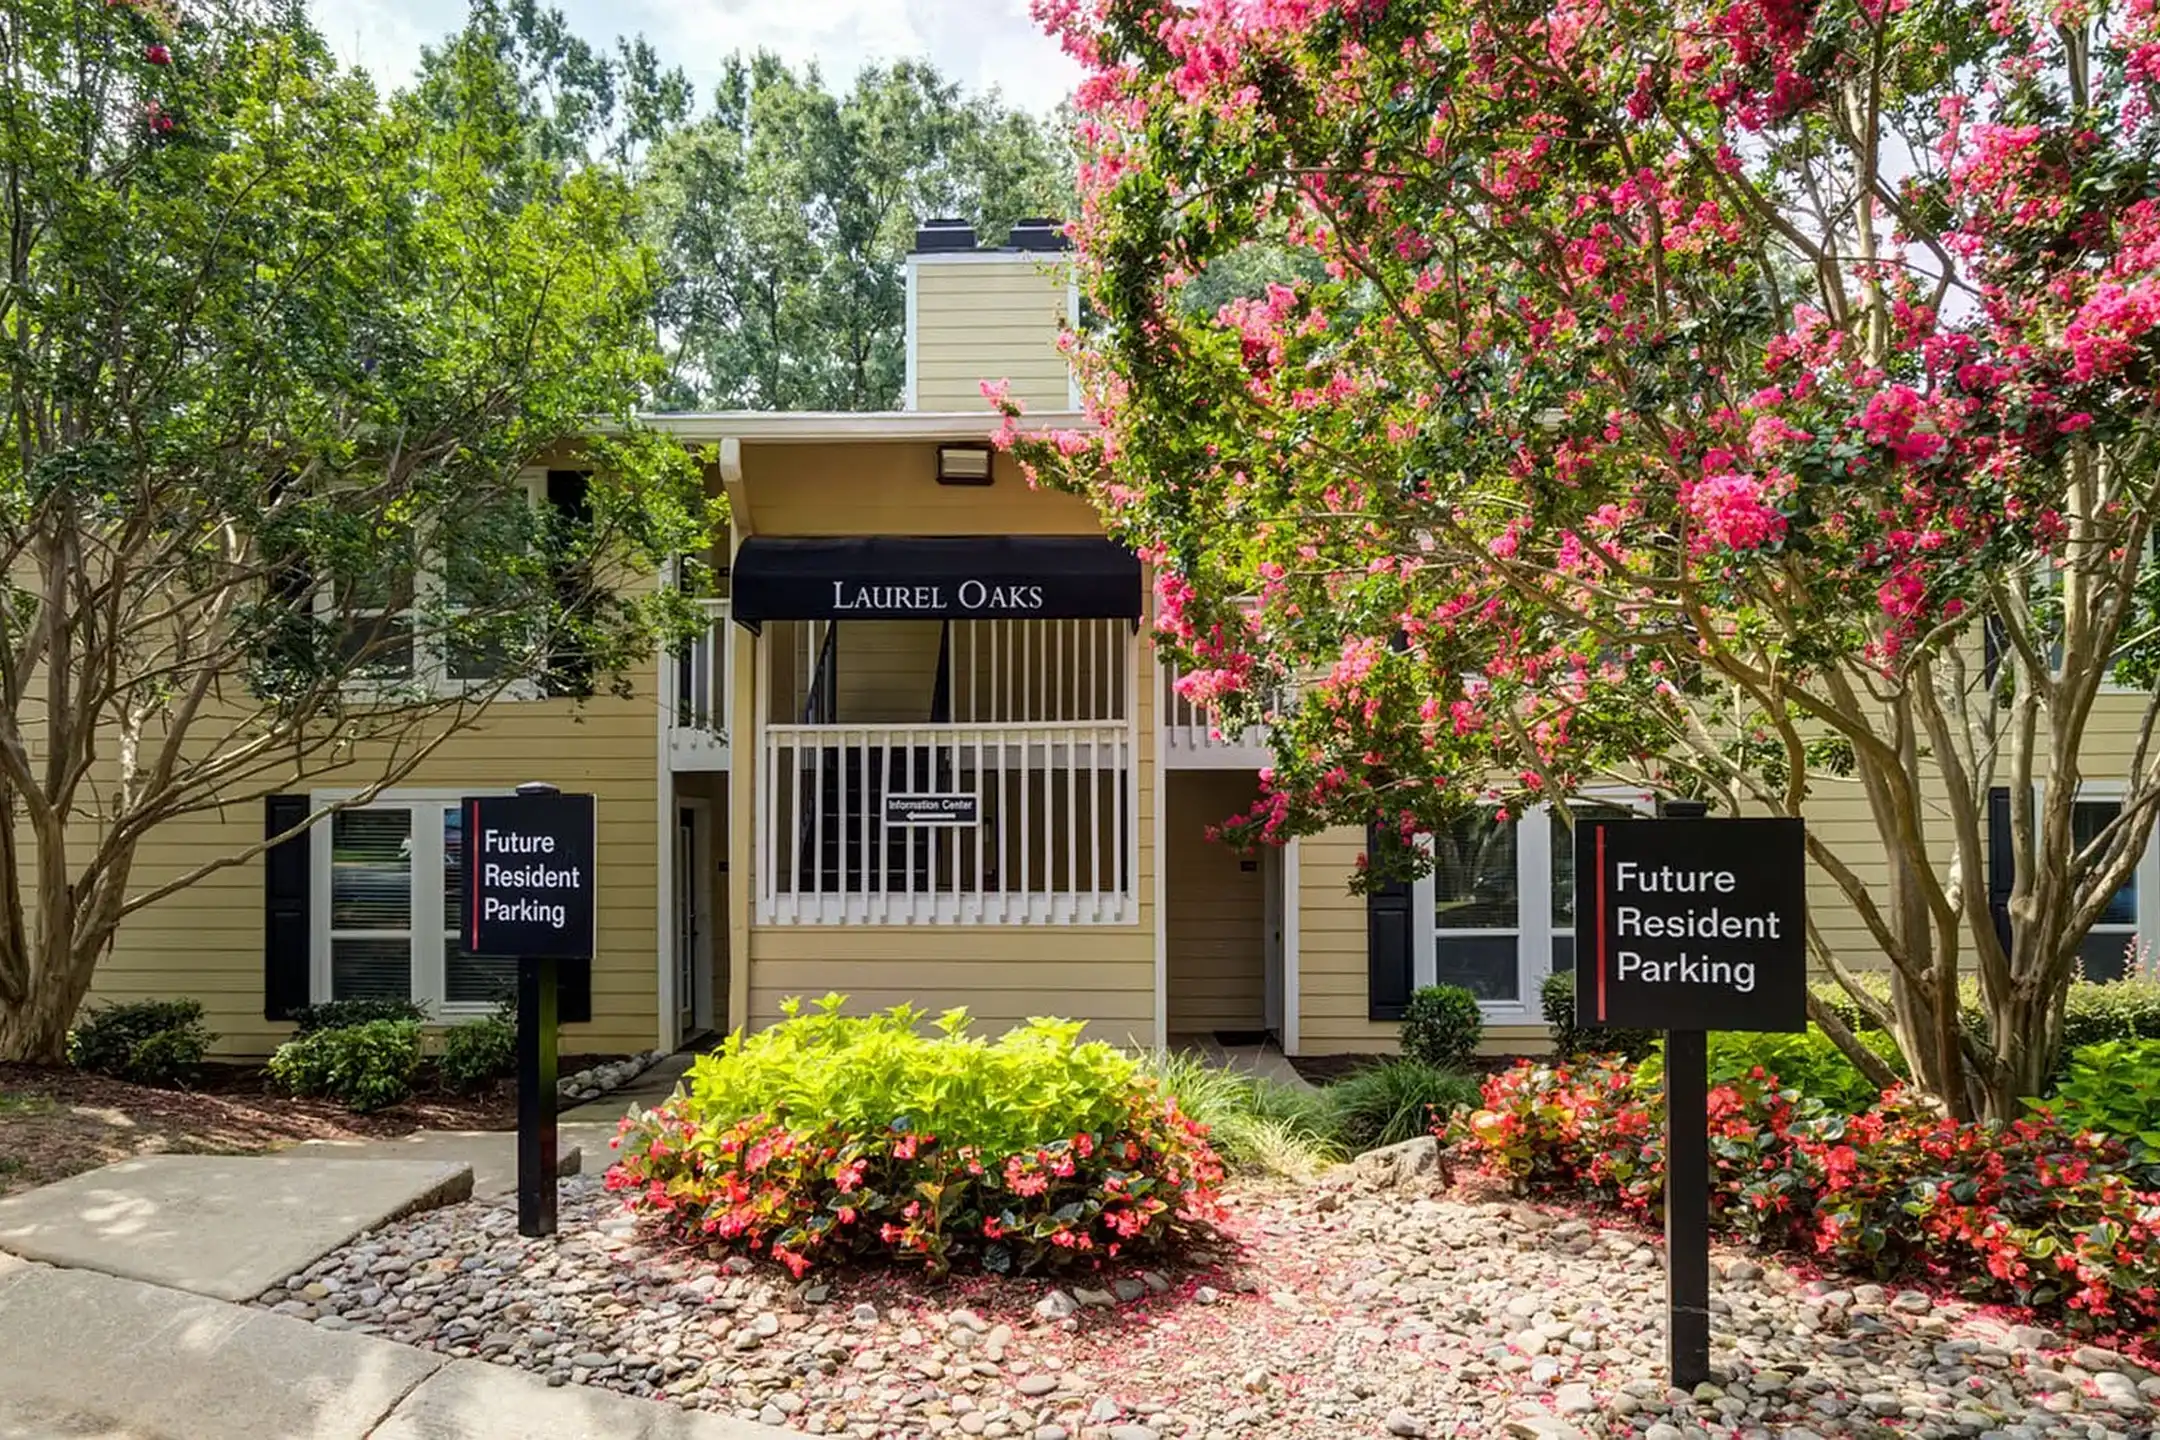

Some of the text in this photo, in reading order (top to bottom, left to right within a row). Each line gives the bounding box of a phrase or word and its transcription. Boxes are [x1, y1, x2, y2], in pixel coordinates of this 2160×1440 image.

[833, 580, 1044, 609] LAUREL OAKS
[888, 799, 973, 811] Information Center
[484, 829, 555, 853] Future
[484, 863, 581, 888] Resident
[1616, 862, 1737, 893] Future
[484, 897, 566, 929] Parking
[1617, 906, 1781, 939] Resident
[1617, 951, 1756, 993] Parking
